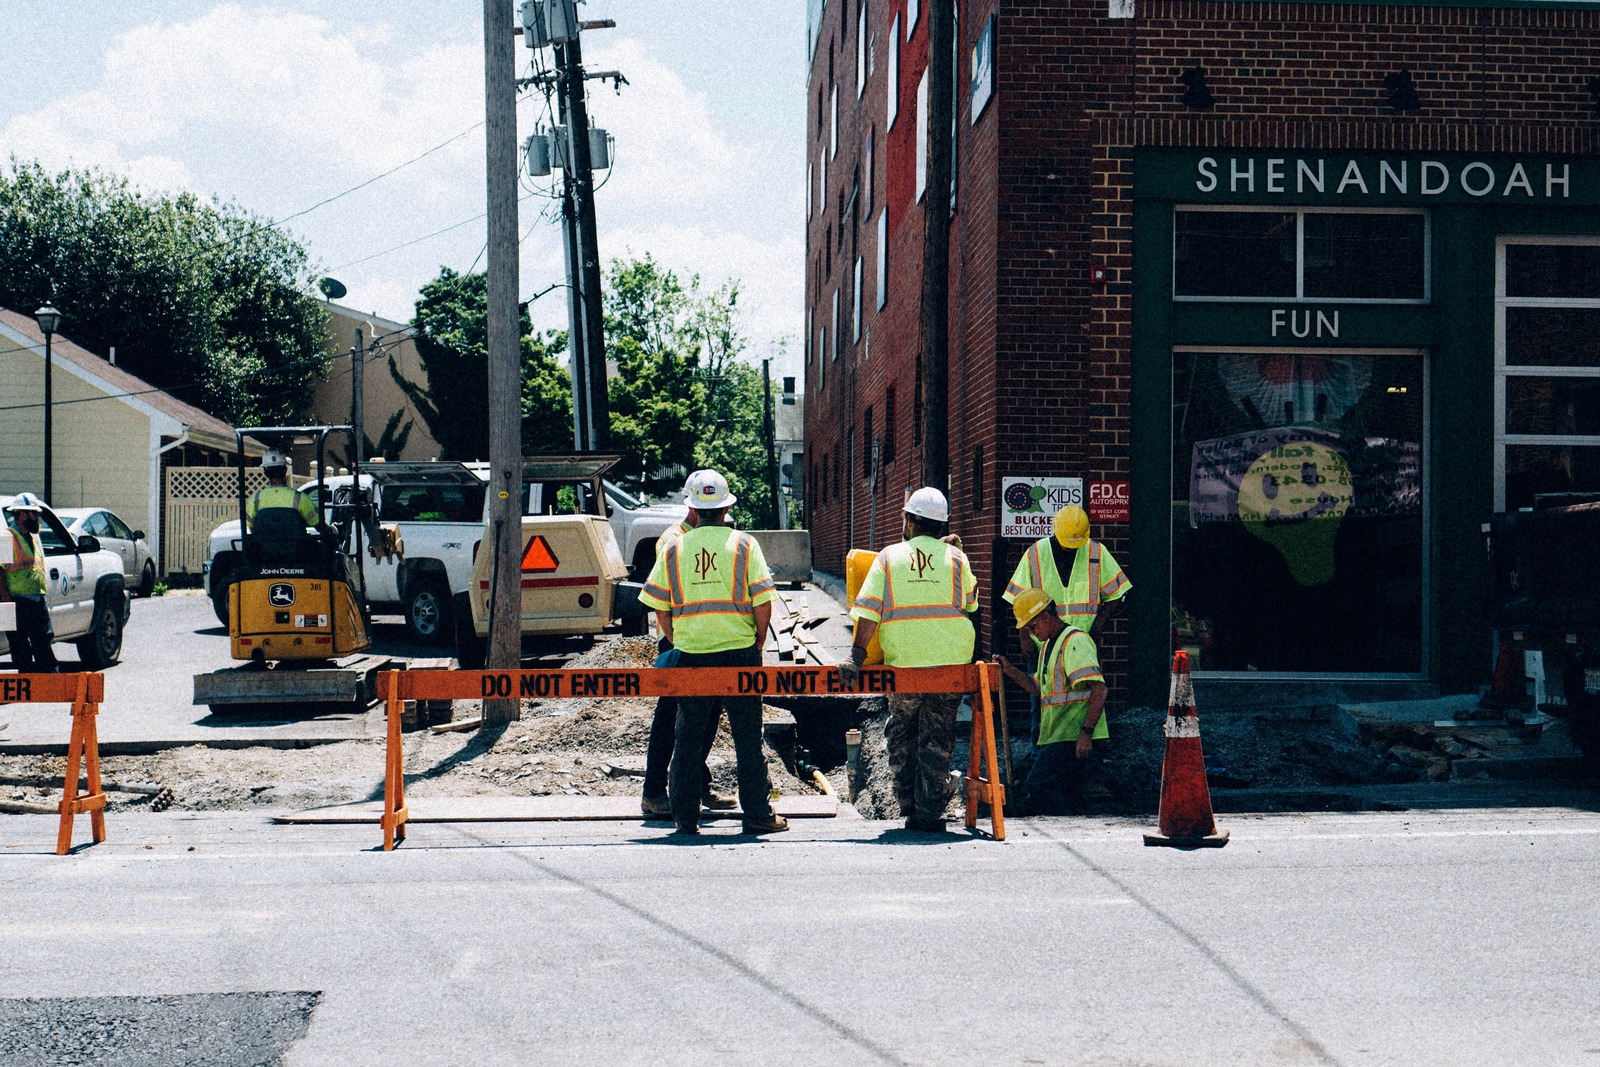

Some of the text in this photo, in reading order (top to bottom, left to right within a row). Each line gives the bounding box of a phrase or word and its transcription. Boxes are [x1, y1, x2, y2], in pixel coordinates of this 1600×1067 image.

[1195, 157, 1570, 198] SHENANDOAH
[1271, 309, 1339, 338] FUN
[1047, 488, 1082, 504] KIDS
[1090, 483, 1129, 499] F.D.C.
[1005, 525, 1052, 535] BEST CHOICE
[260, 567, 305, 575] JOHN DEERE
[0, 678, 32, 701] ER
[481, 672, 641, 698] DO NOT ENTER
[738, 671, 769, 694] DO
[776, 670, 820, 694] NOT
